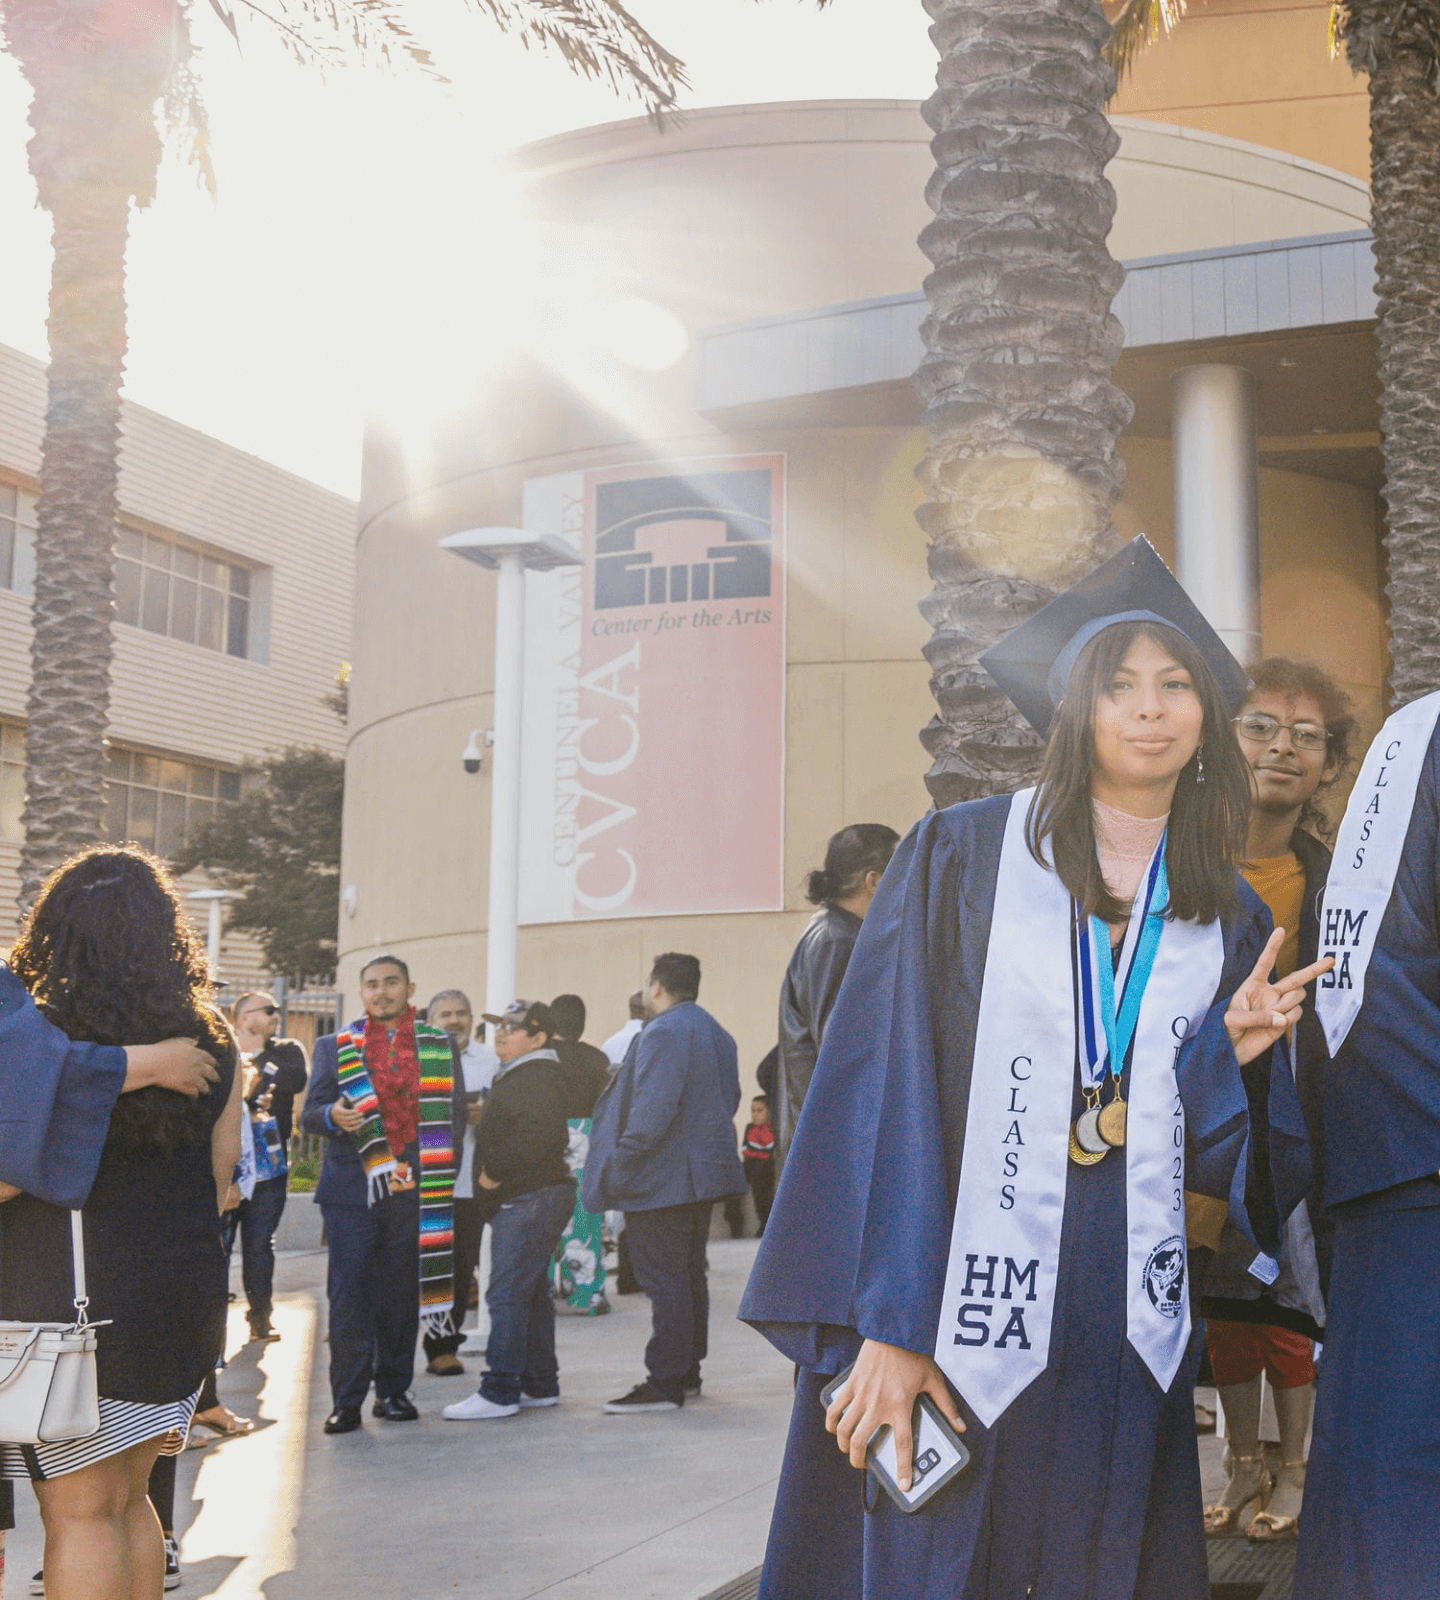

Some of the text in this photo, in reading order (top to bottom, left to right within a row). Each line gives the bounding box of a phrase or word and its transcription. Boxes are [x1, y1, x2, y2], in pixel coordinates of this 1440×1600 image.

[591, 607, 772, 637] Center for the Arts
[553, 492, 584, 868] CENTINELA VALEY
[574, 639, 641, 913] CVCA
[1352, 740, 1401, 870] CLASS
[1324, 908, 1368, 946] HM
[1321, 951, 1353, 989] SA
[1000, 1055, 1032, 1210] CLASS
[1172, 1093, 1183, 1212] 2023
[960, 1253, 1040, 1302] HM
[953, 1303, 1032, 1350] SA
